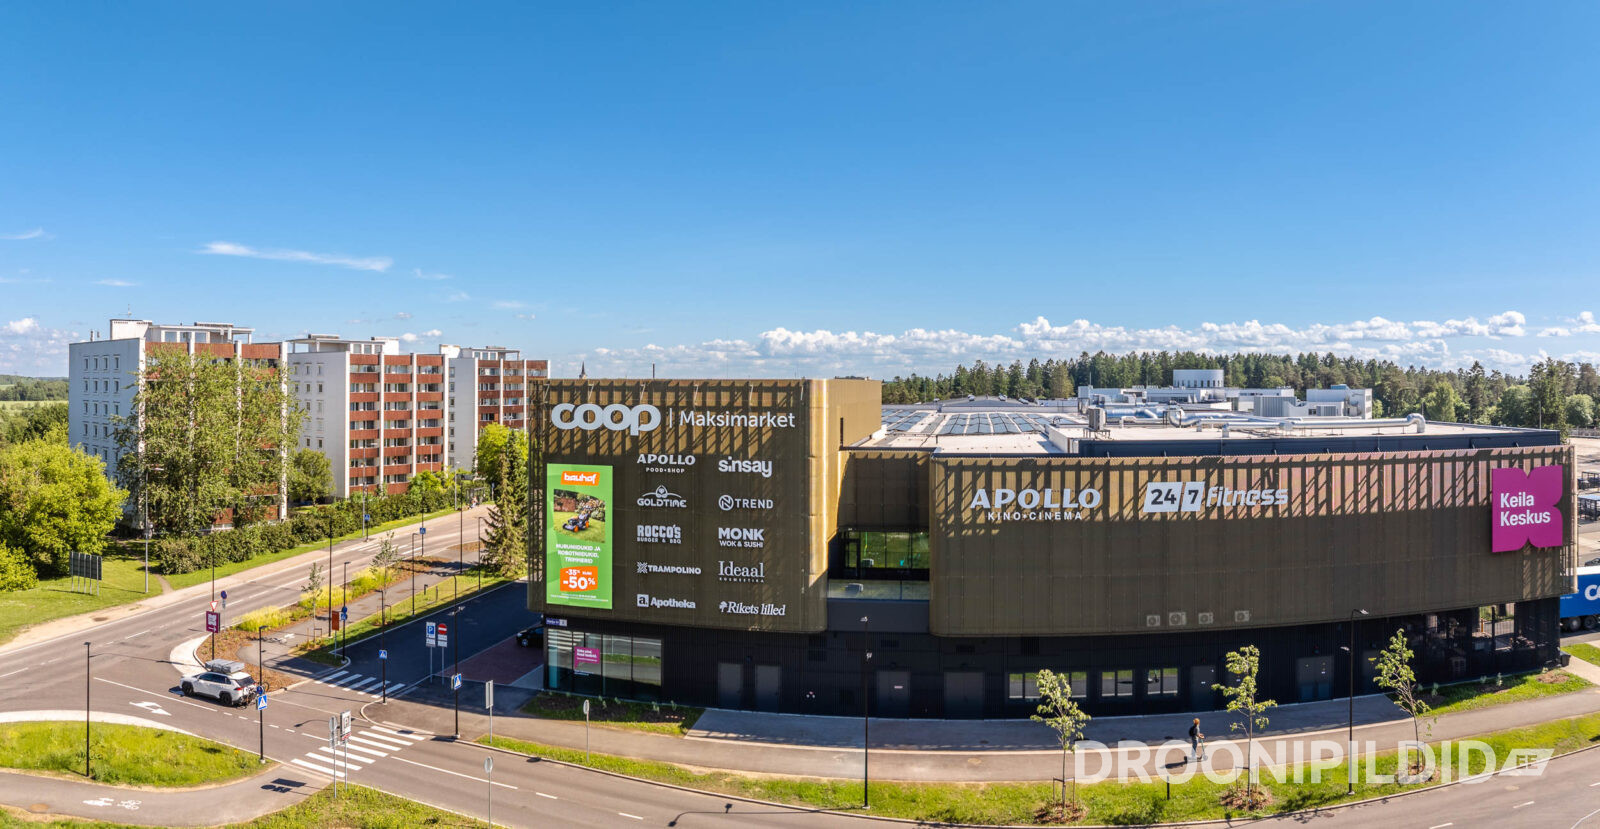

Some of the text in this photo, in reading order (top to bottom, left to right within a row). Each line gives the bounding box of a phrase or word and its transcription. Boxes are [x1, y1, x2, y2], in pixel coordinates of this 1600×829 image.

[551, 403, 660, 436] coop
[679, 411, 795, 428] Maksimarket
[636, 454, 696, 465] APOLLO
[718, 456, 772, 478] sinsay
[564, 473, 597, 485] bauhof
[637, 498, 687, 508] GOLDTIME
[735, 498, 774, 509] TREND
[970, 488, 1101, 508] APOLLO
[1206, 486, 1288, 507] fitness
[1500, 492, 1534, 508] Keila
[1500, 510, 1550, 526] Keskus
[637, 524, 681, 538] ROCCO'S
[718, 527, 764, 541] MONK
[648, 564, 701, 574] TRAMPOLINO
[718, 561, 765, 577] Ideaal
[563, 576, 596, 589] -50%
[650, 597, 696, 609] Apotheka
[727, 601, 786, 615] Rikets lilled
